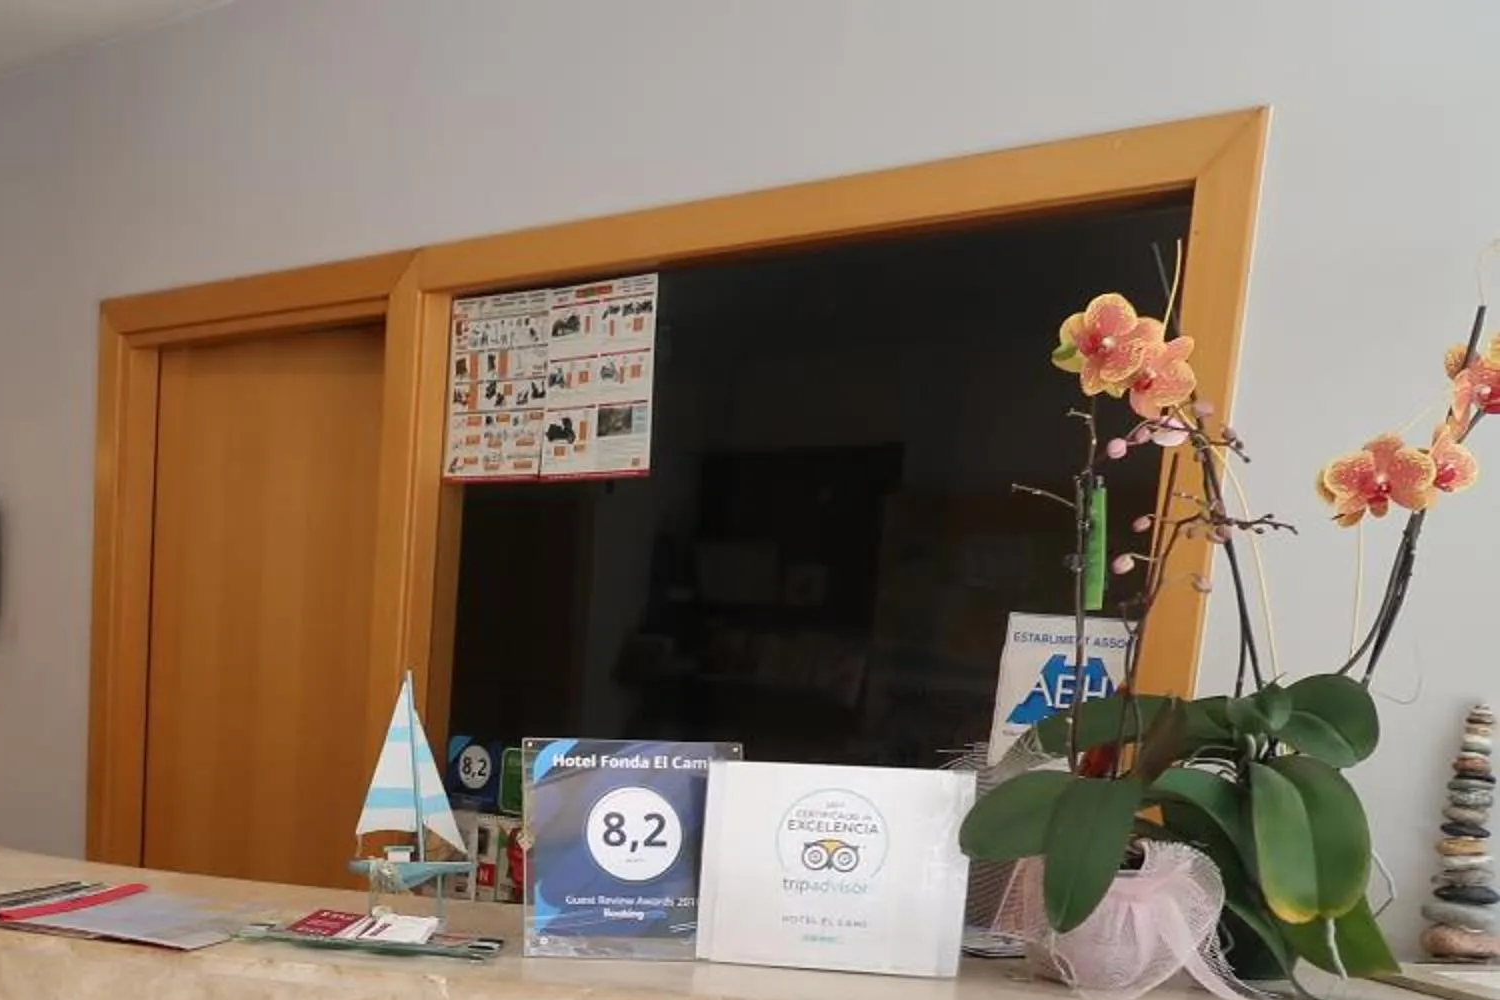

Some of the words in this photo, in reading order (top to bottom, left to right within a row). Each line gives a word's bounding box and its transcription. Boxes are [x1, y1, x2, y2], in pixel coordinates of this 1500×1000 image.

[1013, 631, 1090, 647] ESTABLIMET
[1093, 637, 1129, 650] ASSO
[462, 756, 488, 778] 8,2
[552, 753, 596, 768] Hotel
[601, 754, 649, 769] Fonda
[653, 756, 668, 769] El
[602, 812, 668, 853] 8,2
[787, 819, 879, 835] EXCELENCIA
[783, 878, 868, 895] tripadvisor
[565, 895, 595, 906] Guest
[599, 896, 635, 906] Review
[637, 896, 675, 907] Awards
